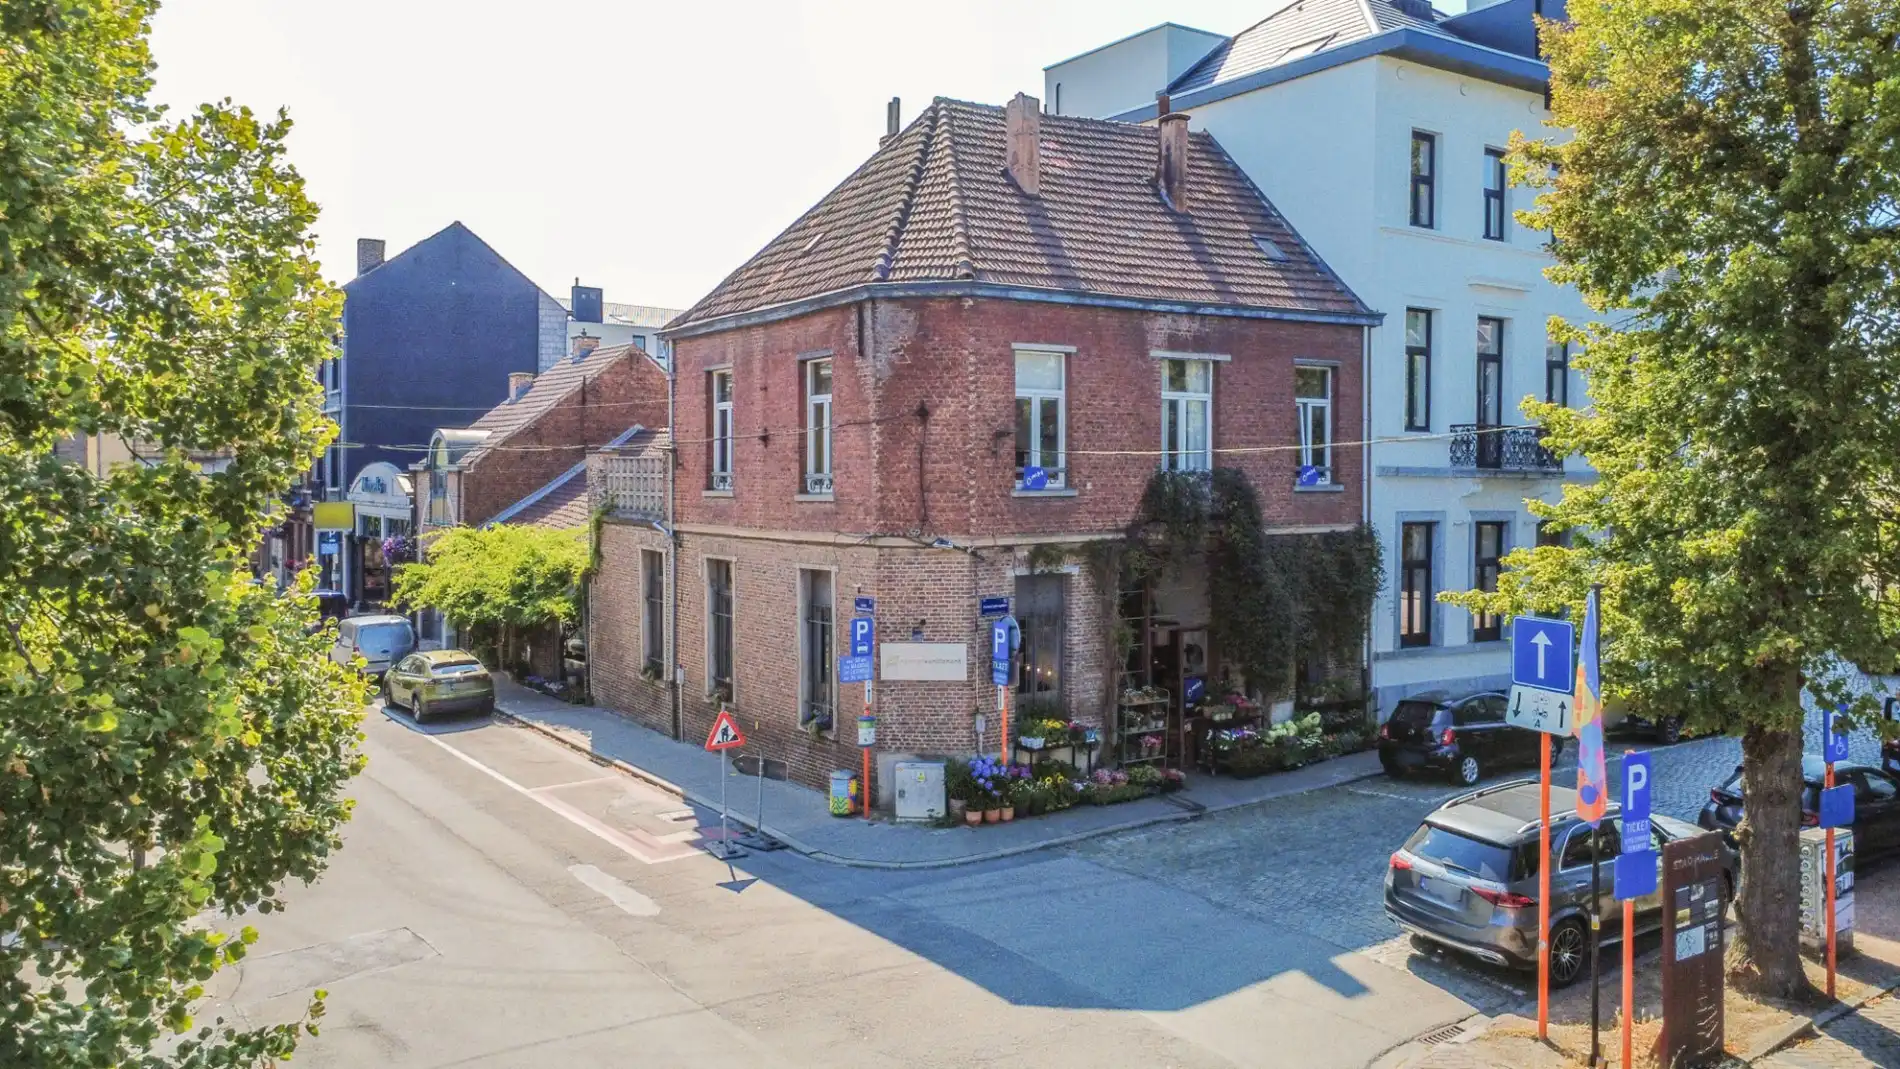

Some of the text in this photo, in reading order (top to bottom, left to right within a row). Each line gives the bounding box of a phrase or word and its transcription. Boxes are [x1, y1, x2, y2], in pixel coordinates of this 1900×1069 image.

[856, 621, 868, 640] P
[995, 628, 1006, 653] P
[1534, 718, 1541, 728] A
[1628, 764, 1648, 810] P
[1626, 820, 1650, 834] TICKET
